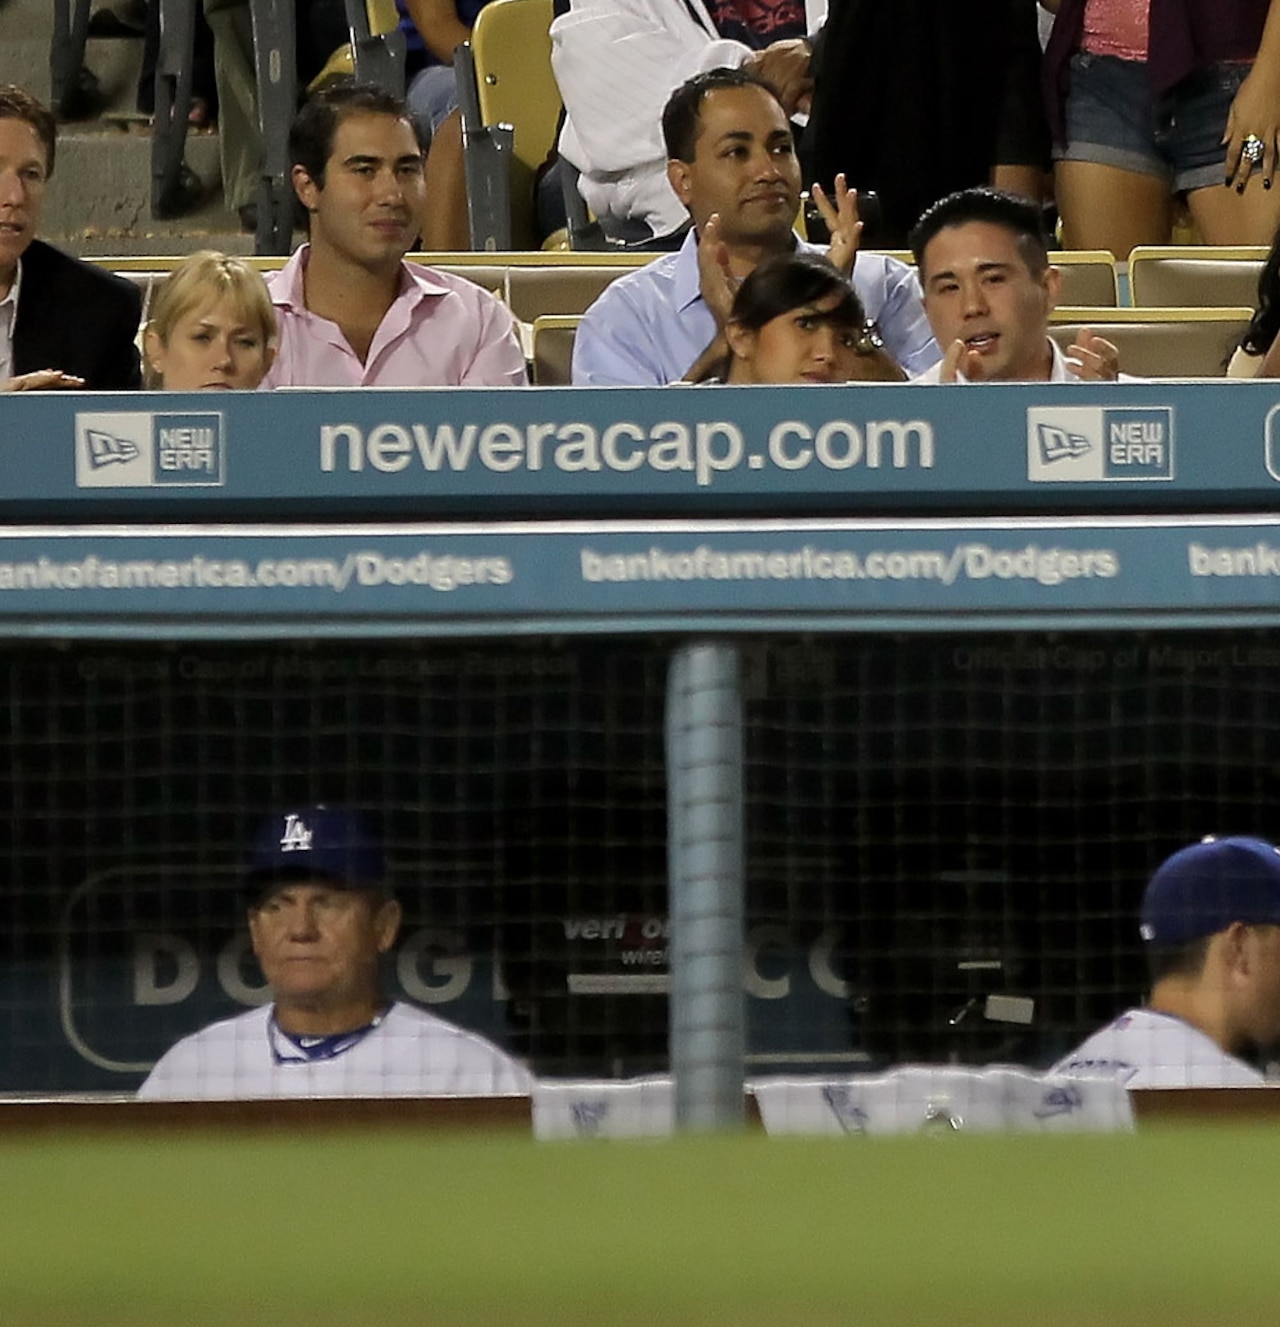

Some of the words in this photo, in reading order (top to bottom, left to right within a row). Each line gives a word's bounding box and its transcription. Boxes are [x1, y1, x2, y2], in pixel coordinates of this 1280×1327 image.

[160, 428, 212, 449] NEW
[1110, 423, 1163, 442] NEW
[160, 449, 212, 471] ERA
[320, 420, 934, 486] neweracap.com
[1110, 443, 1163, 465] ERA
[0, 551, 512, 591] ankofamerica.com/Dodgers
[580, 544, 1119, 585] bankofamerica.com/Dodgers
[280, 814, 313, 852] LA
